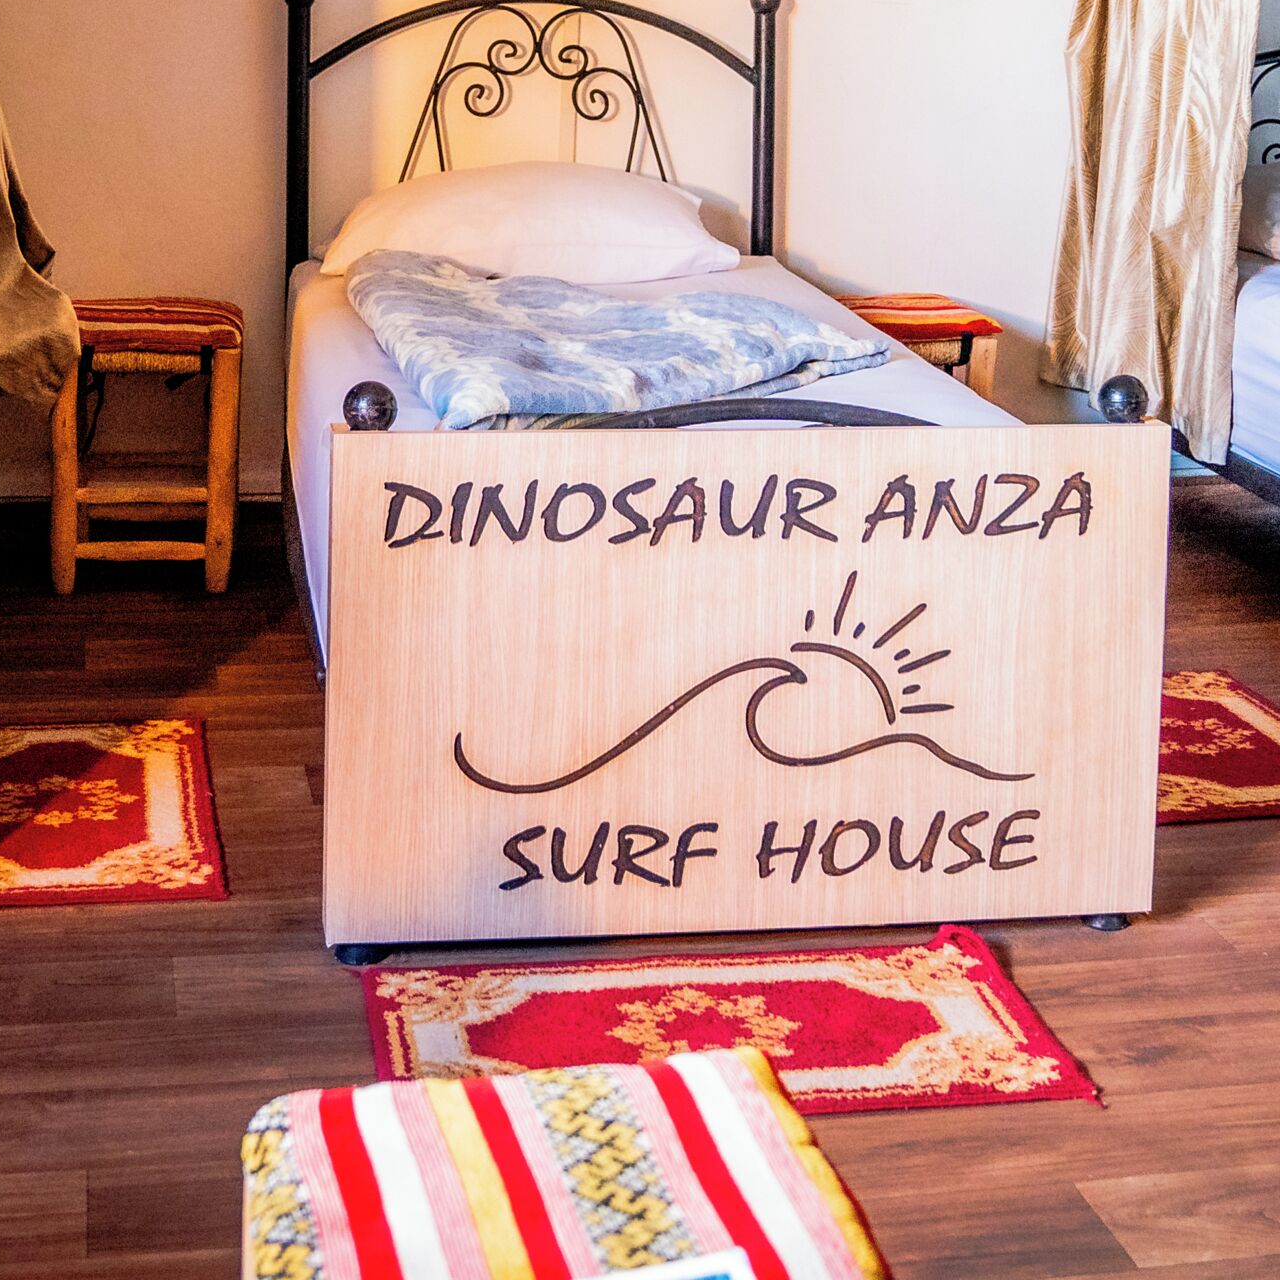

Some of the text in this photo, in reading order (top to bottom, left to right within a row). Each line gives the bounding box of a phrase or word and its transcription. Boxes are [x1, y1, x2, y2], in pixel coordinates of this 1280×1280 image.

[383, 471, 1094, 548] DINOSAUR ANZA
[499, 808, 1041, 892] SURF HOUSE
